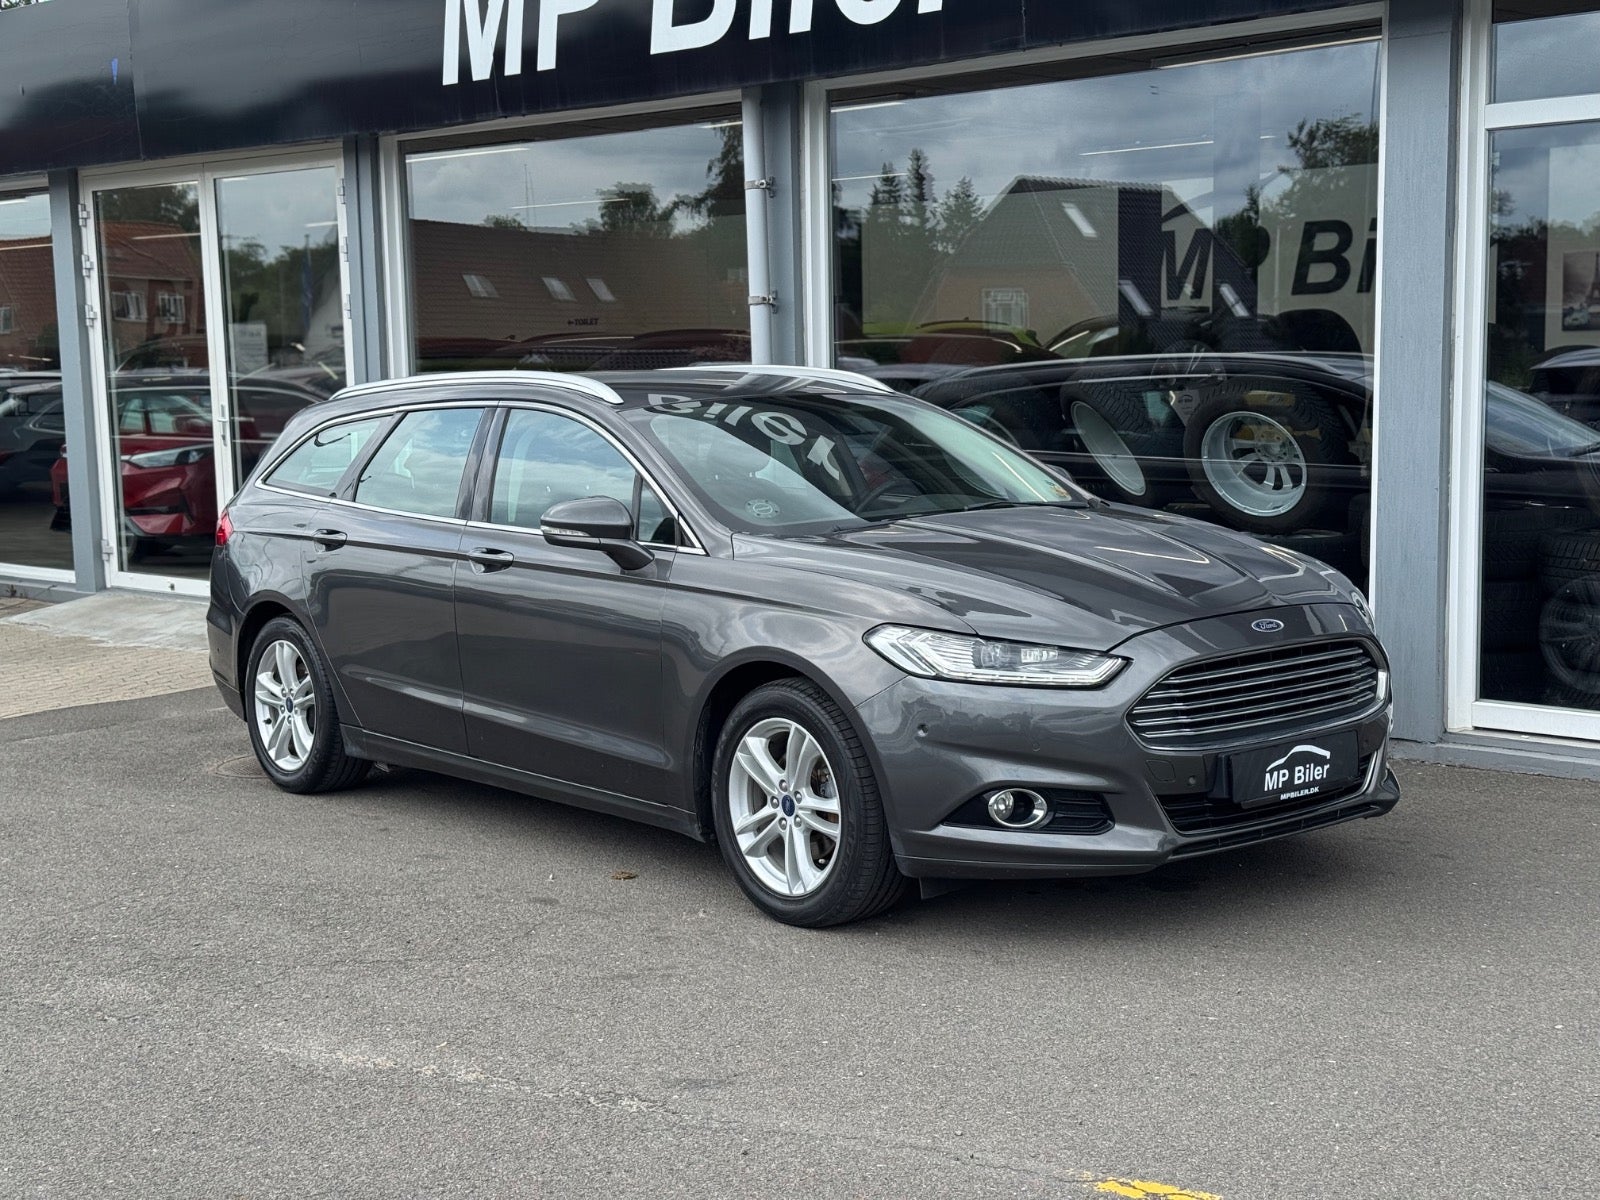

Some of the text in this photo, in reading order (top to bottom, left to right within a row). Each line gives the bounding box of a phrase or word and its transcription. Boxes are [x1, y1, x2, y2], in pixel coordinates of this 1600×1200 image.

[1264, 763, 1330, 792] MP Biler
[1280, 787, 1320, 800] MPBILER.DK
